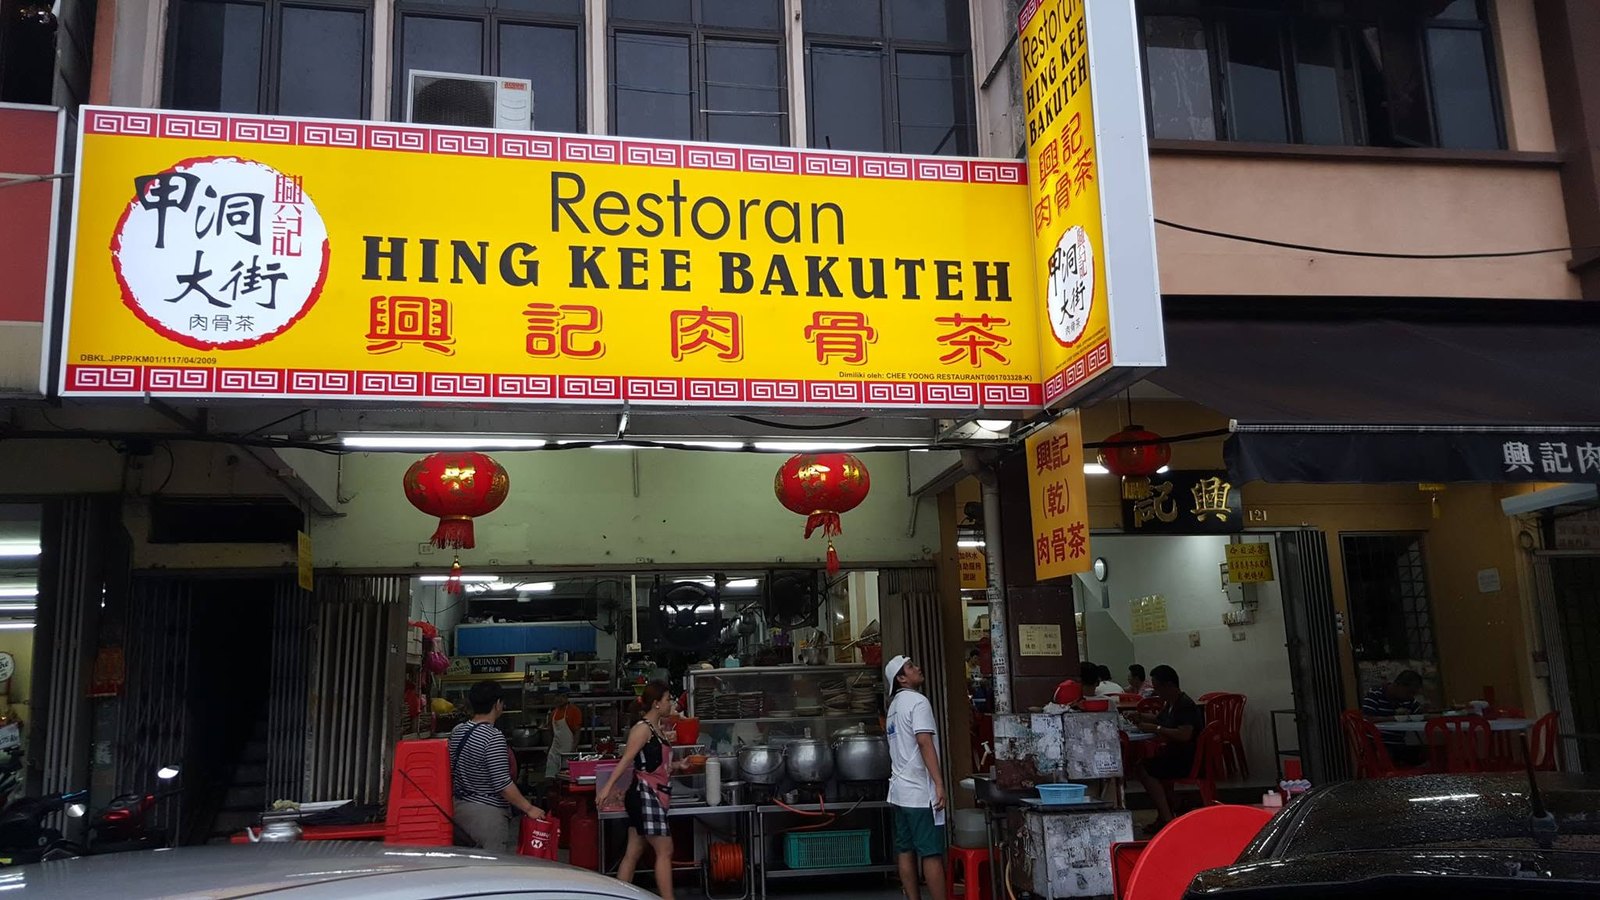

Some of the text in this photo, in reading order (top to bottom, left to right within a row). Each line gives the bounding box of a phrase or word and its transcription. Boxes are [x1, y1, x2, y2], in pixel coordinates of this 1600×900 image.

[1026, 17, 1085, 114] HING KEE
[1029, 53, 1088, 147] BAKUTEH
[1039, 111, 1083, 191] 興記
[134, 172, 266, 249] 甲洞
[271, 174, 304, 257] 興記
[551, 170, 845, 245] Restoran
[1034, 147, 1094, 238] 肉骨茶
[163, 250, 289, 310] 大街
[361, 235, 1013, 302] HING KEE BAKUTEH
[189, 314, 255, 332] 肉骨茶
[364, 295, 1012, 368] 興記肉骨茶
[1036, 432, 1070, 476] 興記
[1036, 521, 1086, 566] 肉骨茶
[1249, 509, 1267, 521] 121
[473, 657, 508, 666] GUINNESS
